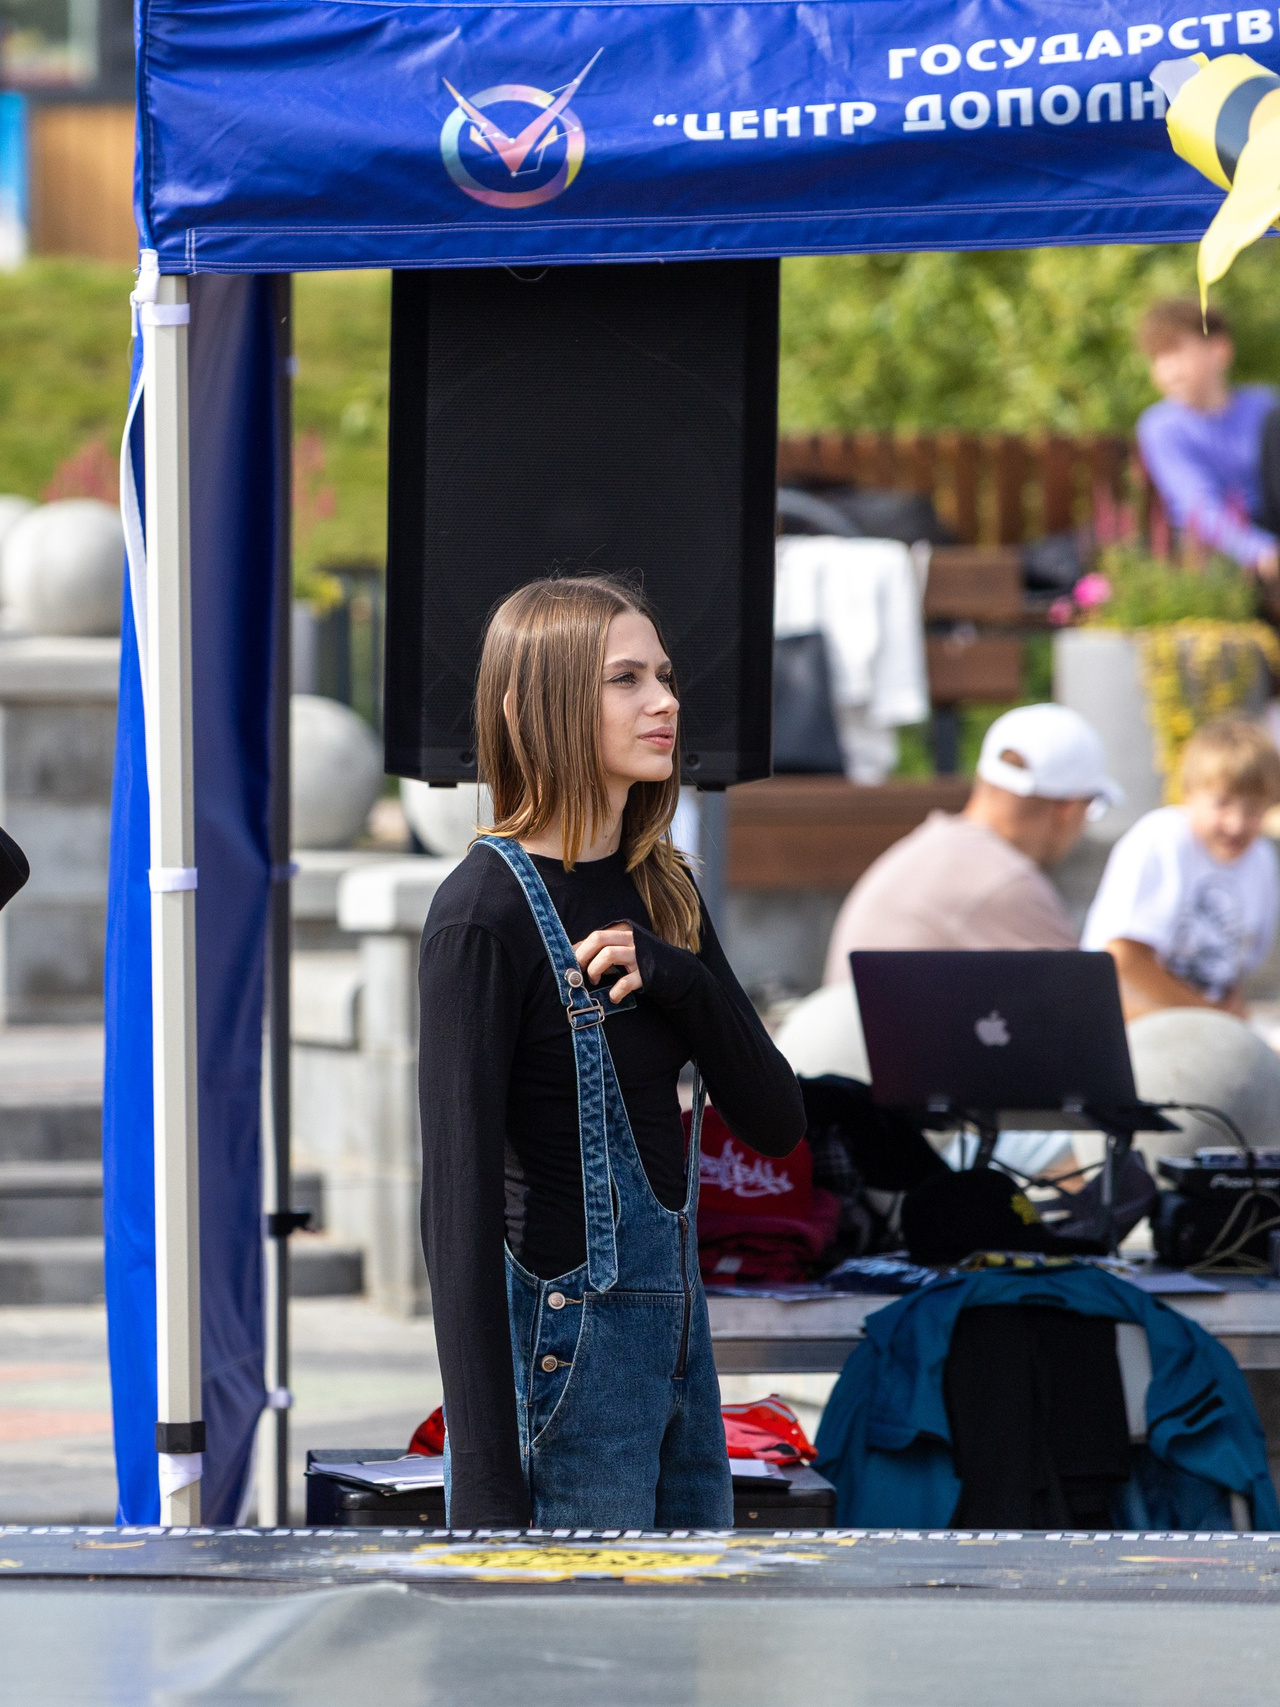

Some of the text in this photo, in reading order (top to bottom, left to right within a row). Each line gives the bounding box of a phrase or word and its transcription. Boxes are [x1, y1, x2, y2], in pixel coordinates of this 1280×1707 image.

[888, 8, 1280, 79] ГОСУДАРСТВ
[652, 81, 1167, 141] “ЦЕНТР ДОПОЛН
[771, 1529, 1023, 1540] ВИДОВ
